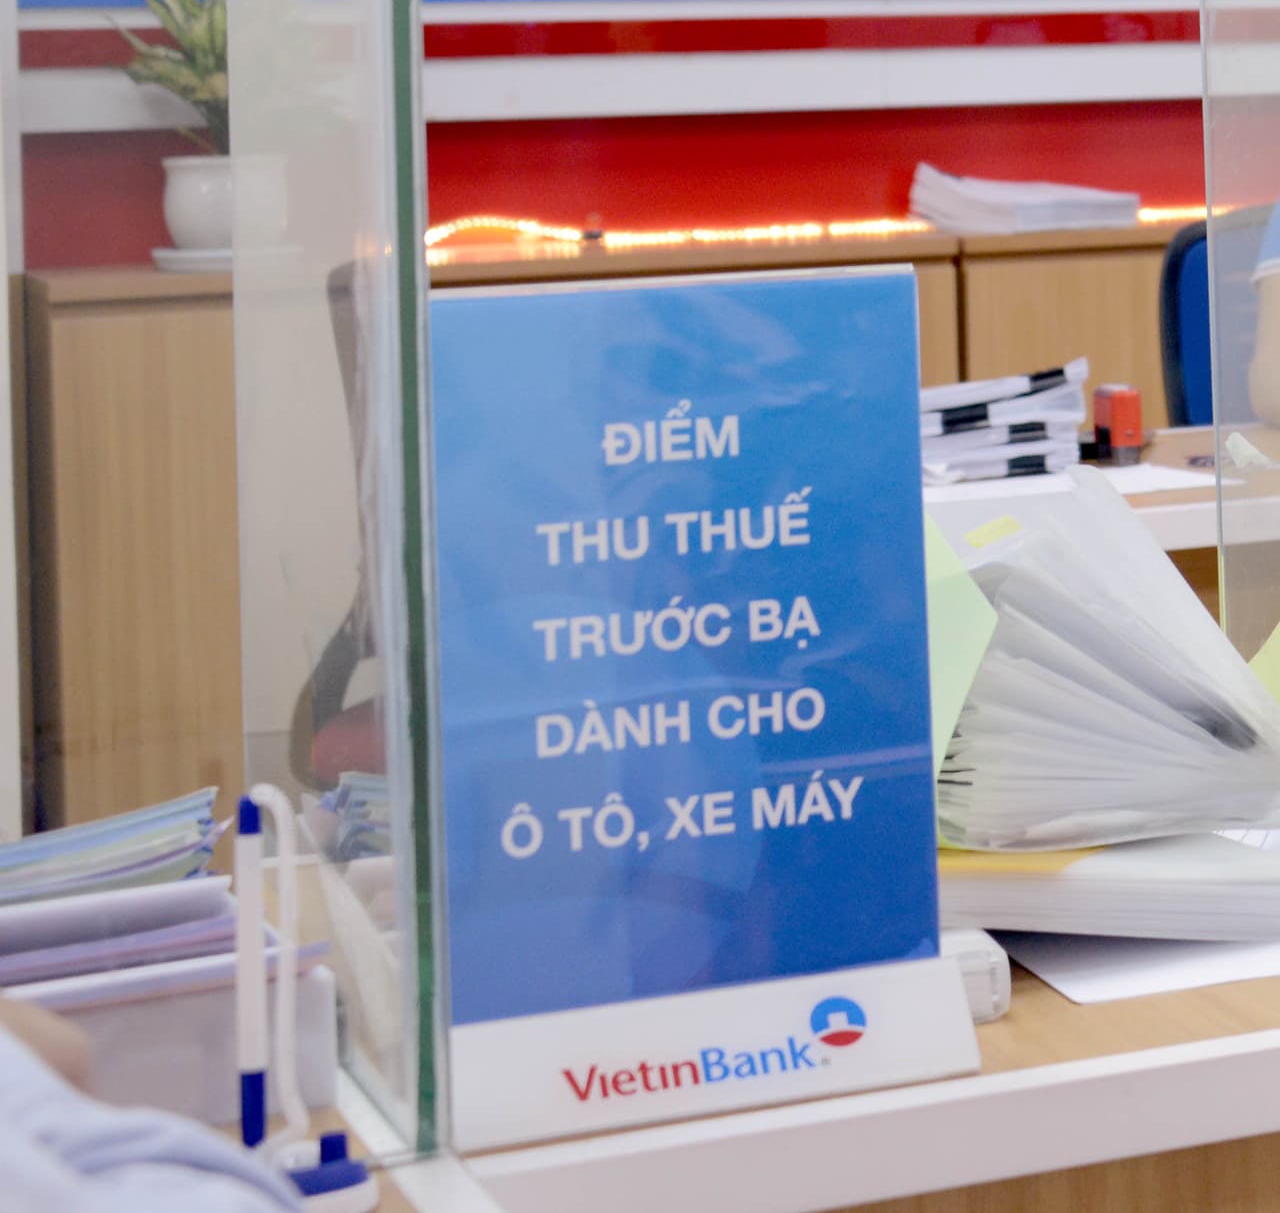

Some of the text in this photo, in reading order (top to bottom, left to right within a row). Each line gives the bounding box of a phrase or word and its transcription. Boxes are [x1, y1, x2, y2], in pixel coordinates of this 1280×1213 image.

[602, 399, 740, 467] ĐIỂM
[536, 487, 813, 566] THU THUẾ
[533, 596, 820, 662] TRƯỚC BẠ
[536, 687, 826, 759] DÀNH CHO
[501, 769, 864, 859] Ô TÔ, XE MÁY
[562, 1036, 816, 1102] VietinBank
